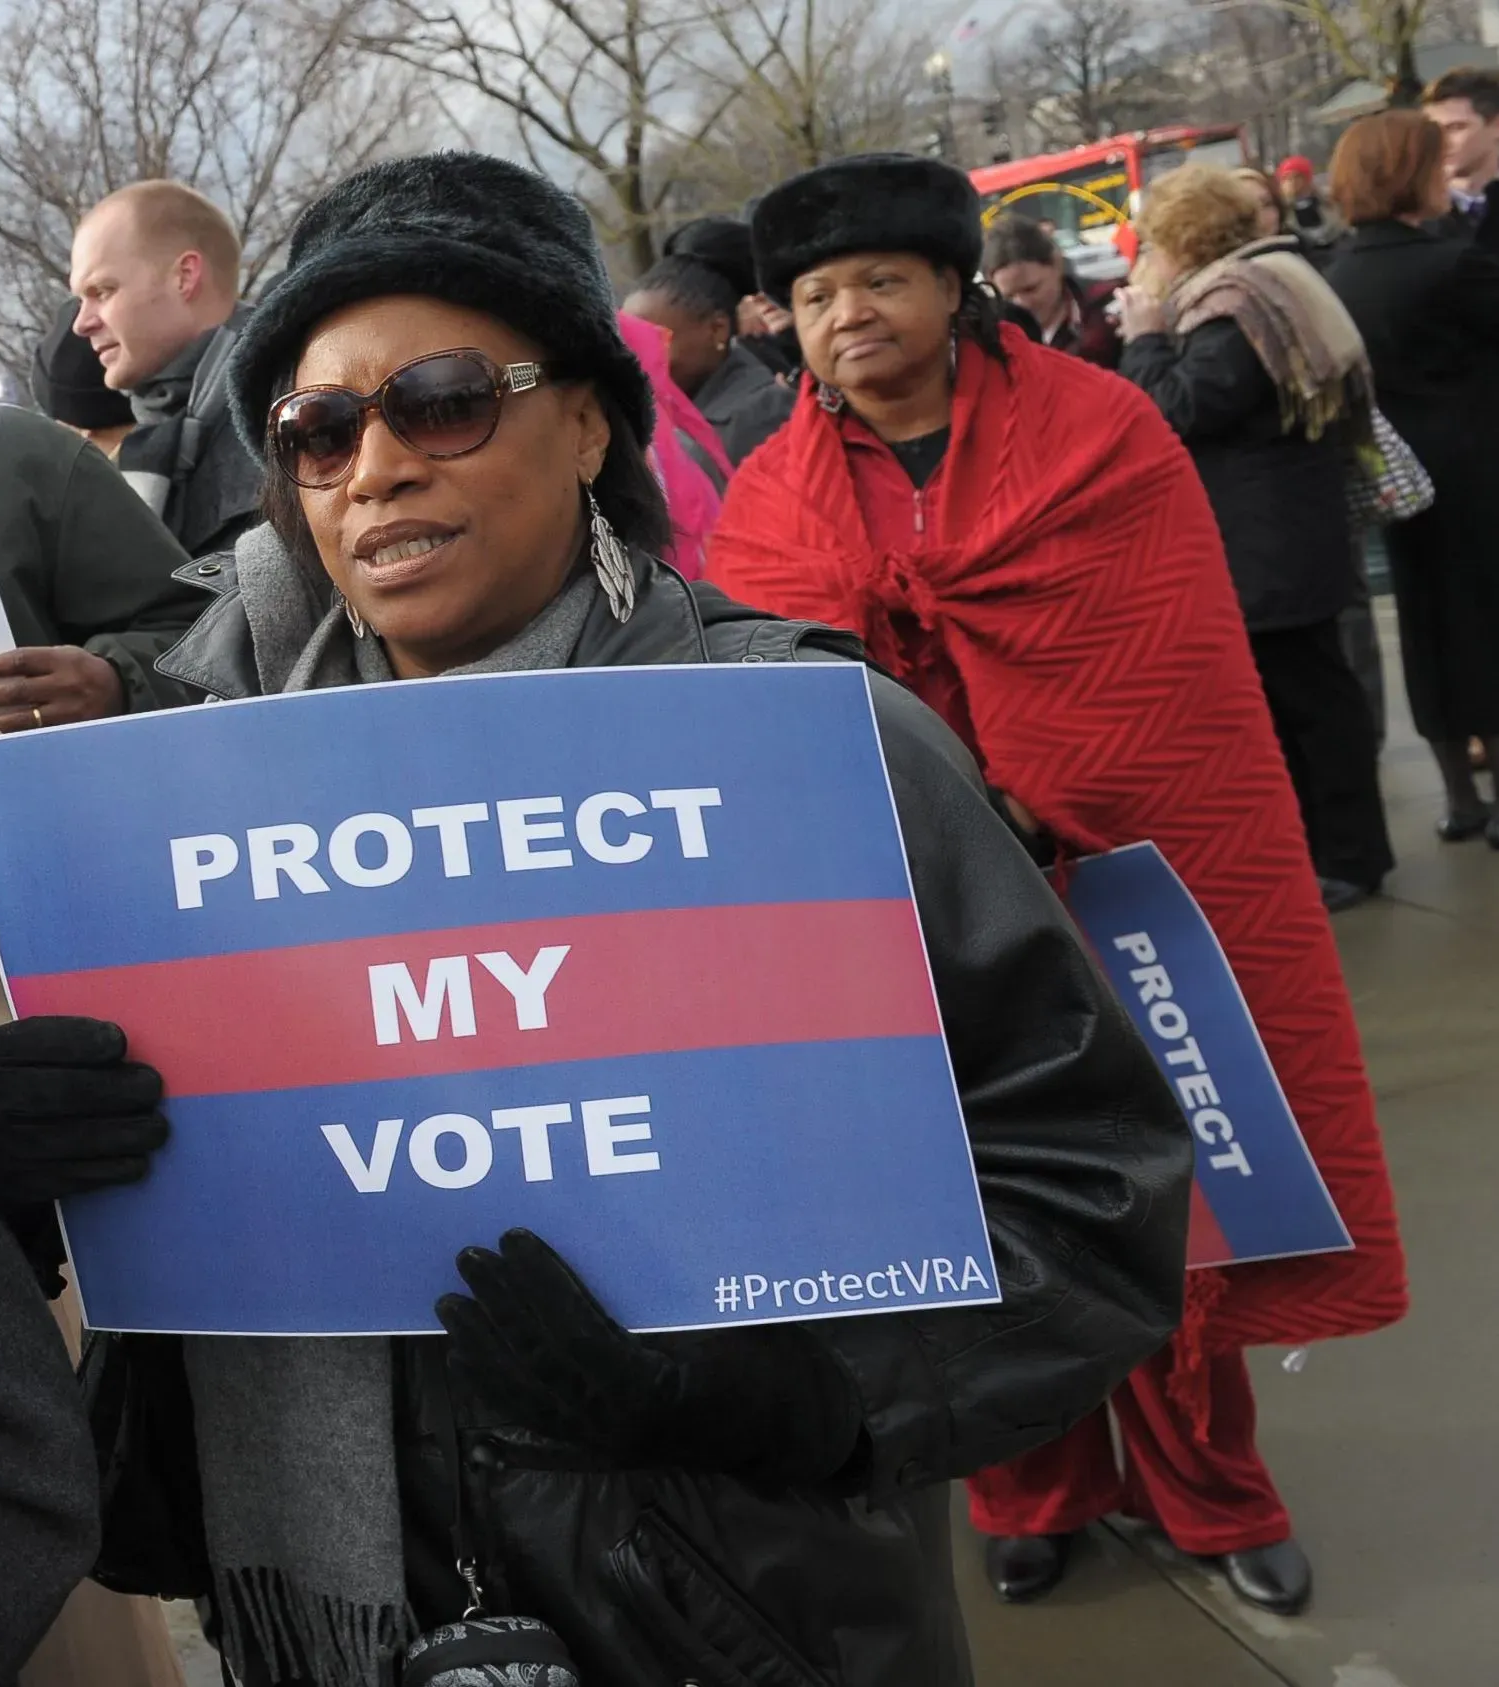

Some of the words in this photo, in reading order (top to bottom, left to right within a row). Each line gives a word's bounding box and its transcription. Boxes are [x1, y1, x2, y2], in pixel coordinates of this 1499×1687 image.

[170, 787, 722, 910] PROTECT
[367, 945, 571, 1046] MY
[1112, 930, 1254, 1178] PROTECT
[320, 1095, 661, 1193] VOTE
[713, 1254, 990, 1313] #ProtectVRA
